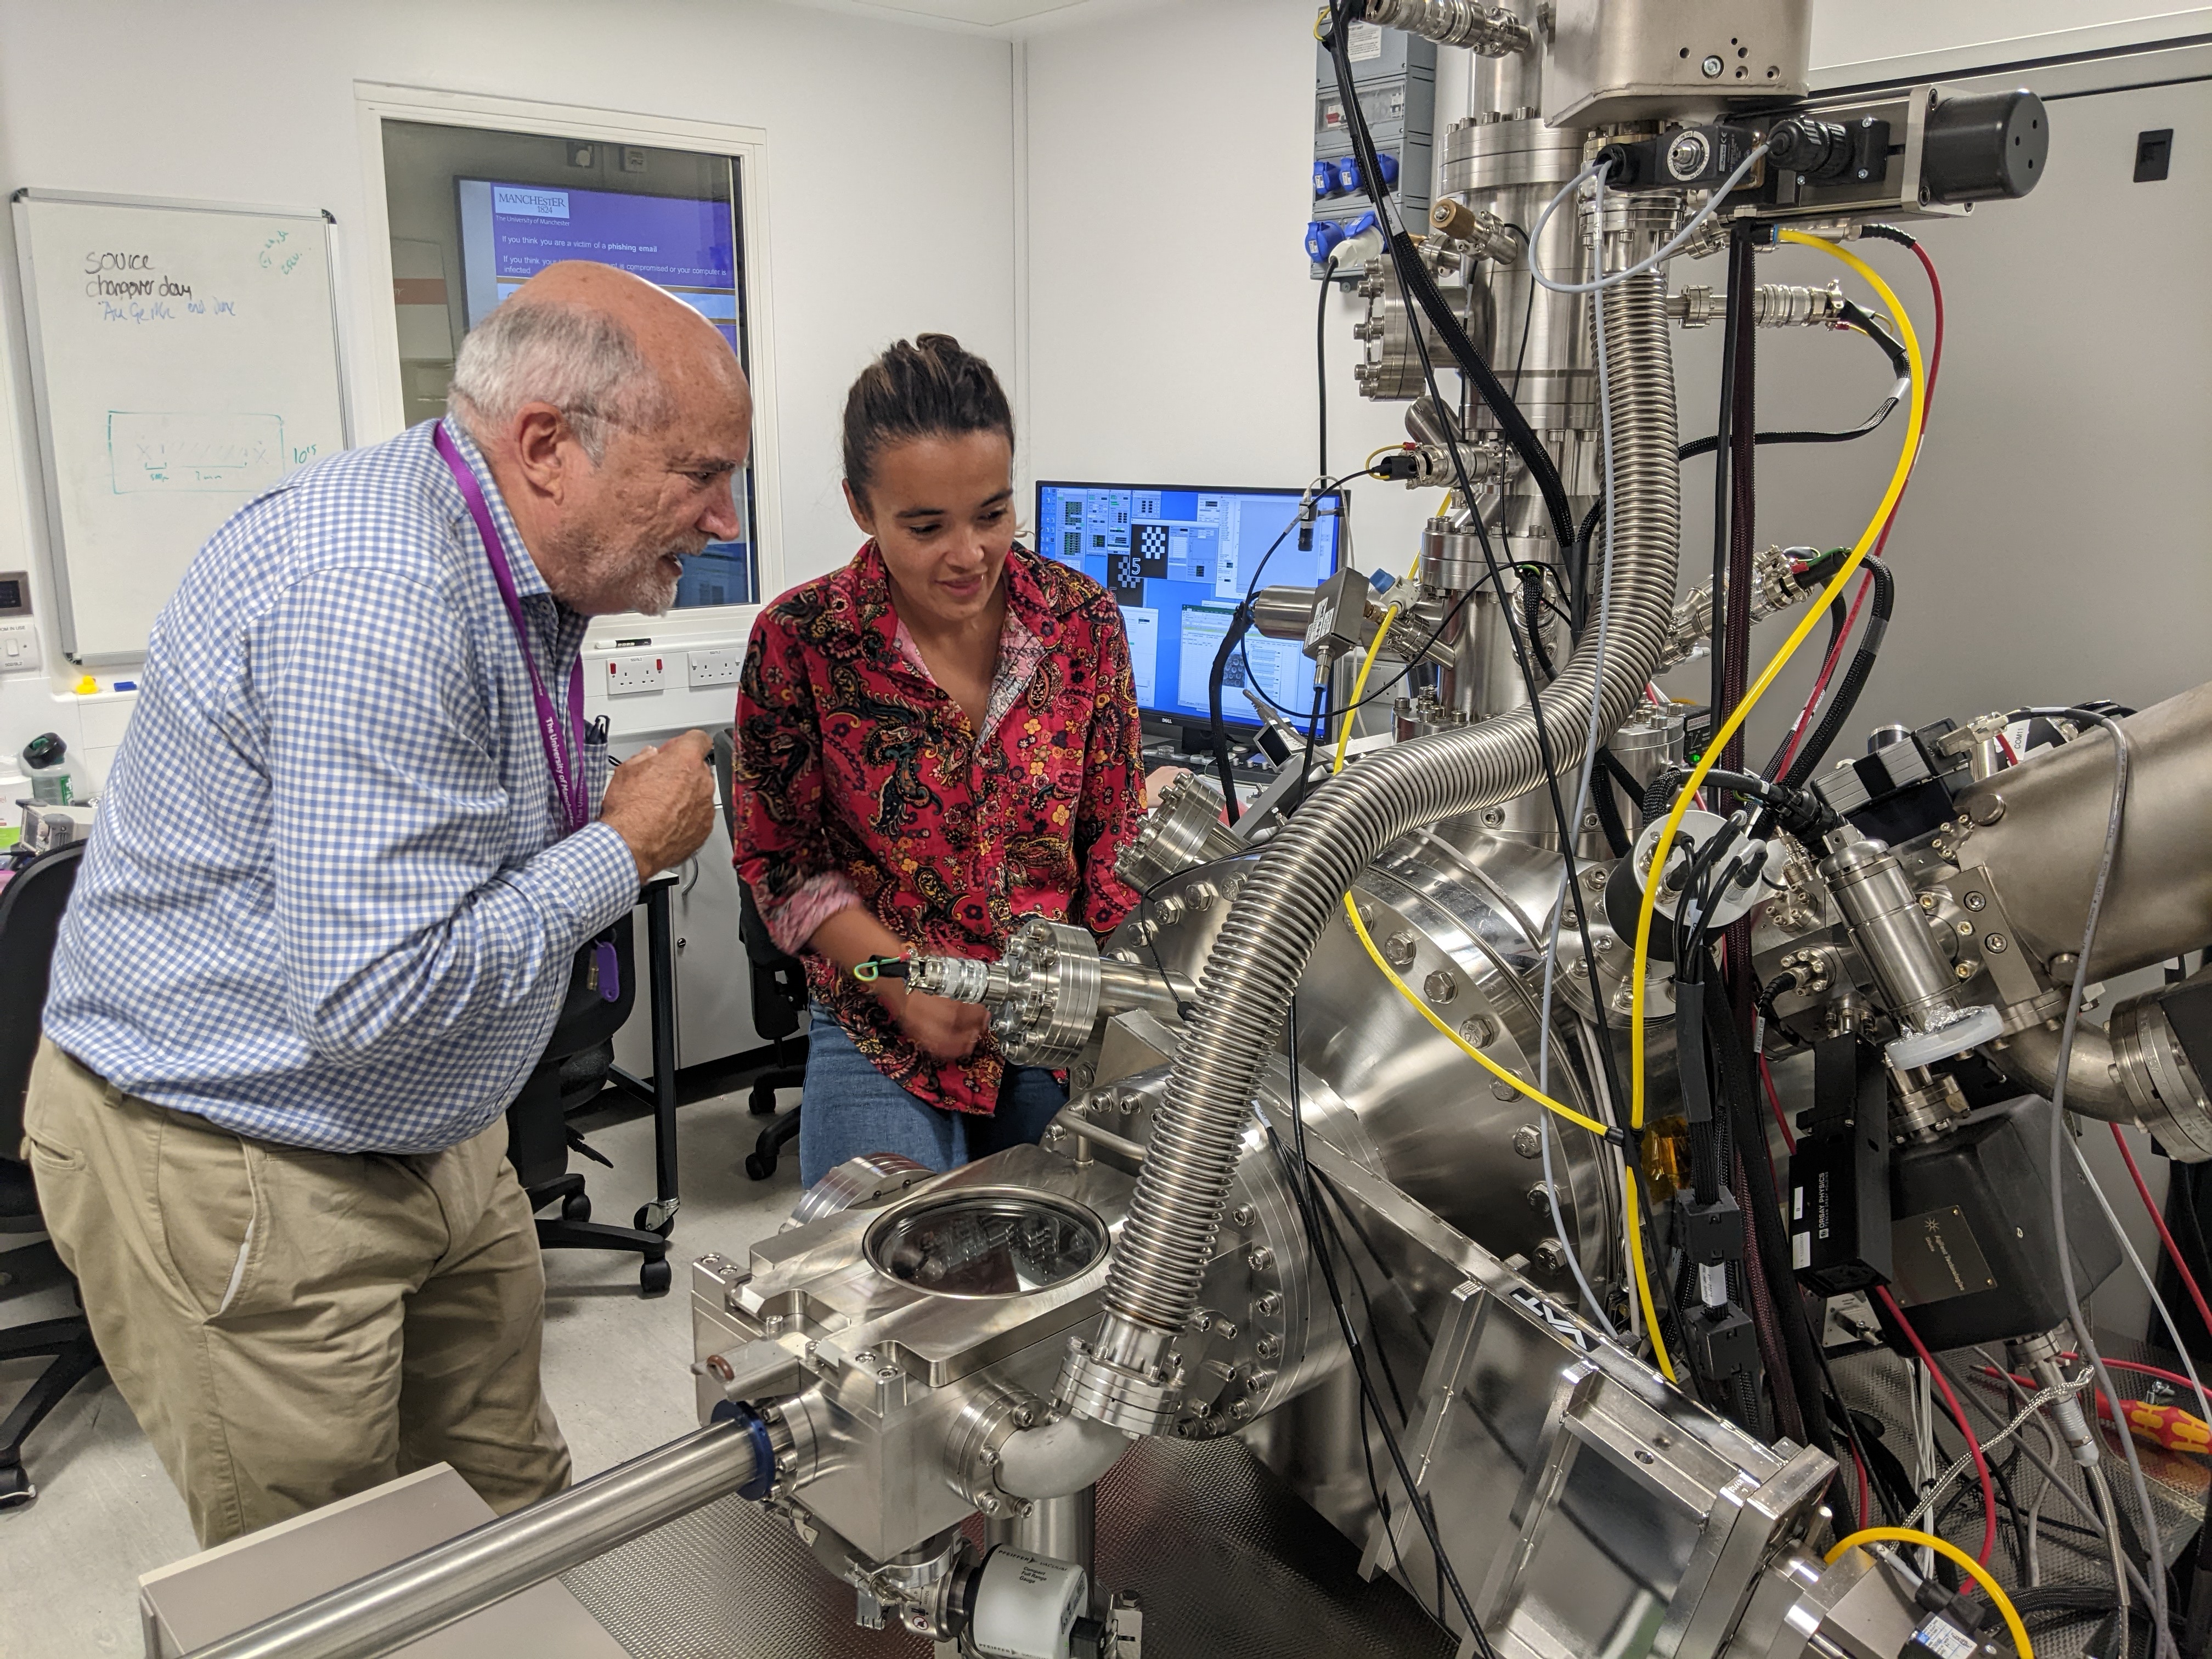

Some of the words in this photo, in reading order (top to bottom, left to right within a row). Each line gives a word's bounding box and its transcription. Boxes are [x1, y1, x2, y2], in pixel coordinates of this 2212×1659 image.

[499, 193, 566, 207] MANCHESTER
[507, 216, 532, 225] University
[608, 244, 636, 252] phishing
[504, 266, 531, 274] infected
[1131, 557, 1141, 575] 5
[545, 717, 554, 734] The
[2014, 728, 2024, 749] COM11
[550, 733, 564, 775] University
[558, 773, 567, 785] of
[560, 781, 574, 827] Manchester
[1934, 1235, 1948, 1255] Agilent
[1945, 1255, 1965, 1290] Technologies
[998, 1550, 1029, 1561] PFEIFFER
[1040, 1562, 1068, 1571] VACUUM
[1023, 1566, 1046, 1576] Compact
[1019, 1576, 1035, 1584] Gauge
[979, 1643, 1010, 1652] PFEIFFER
